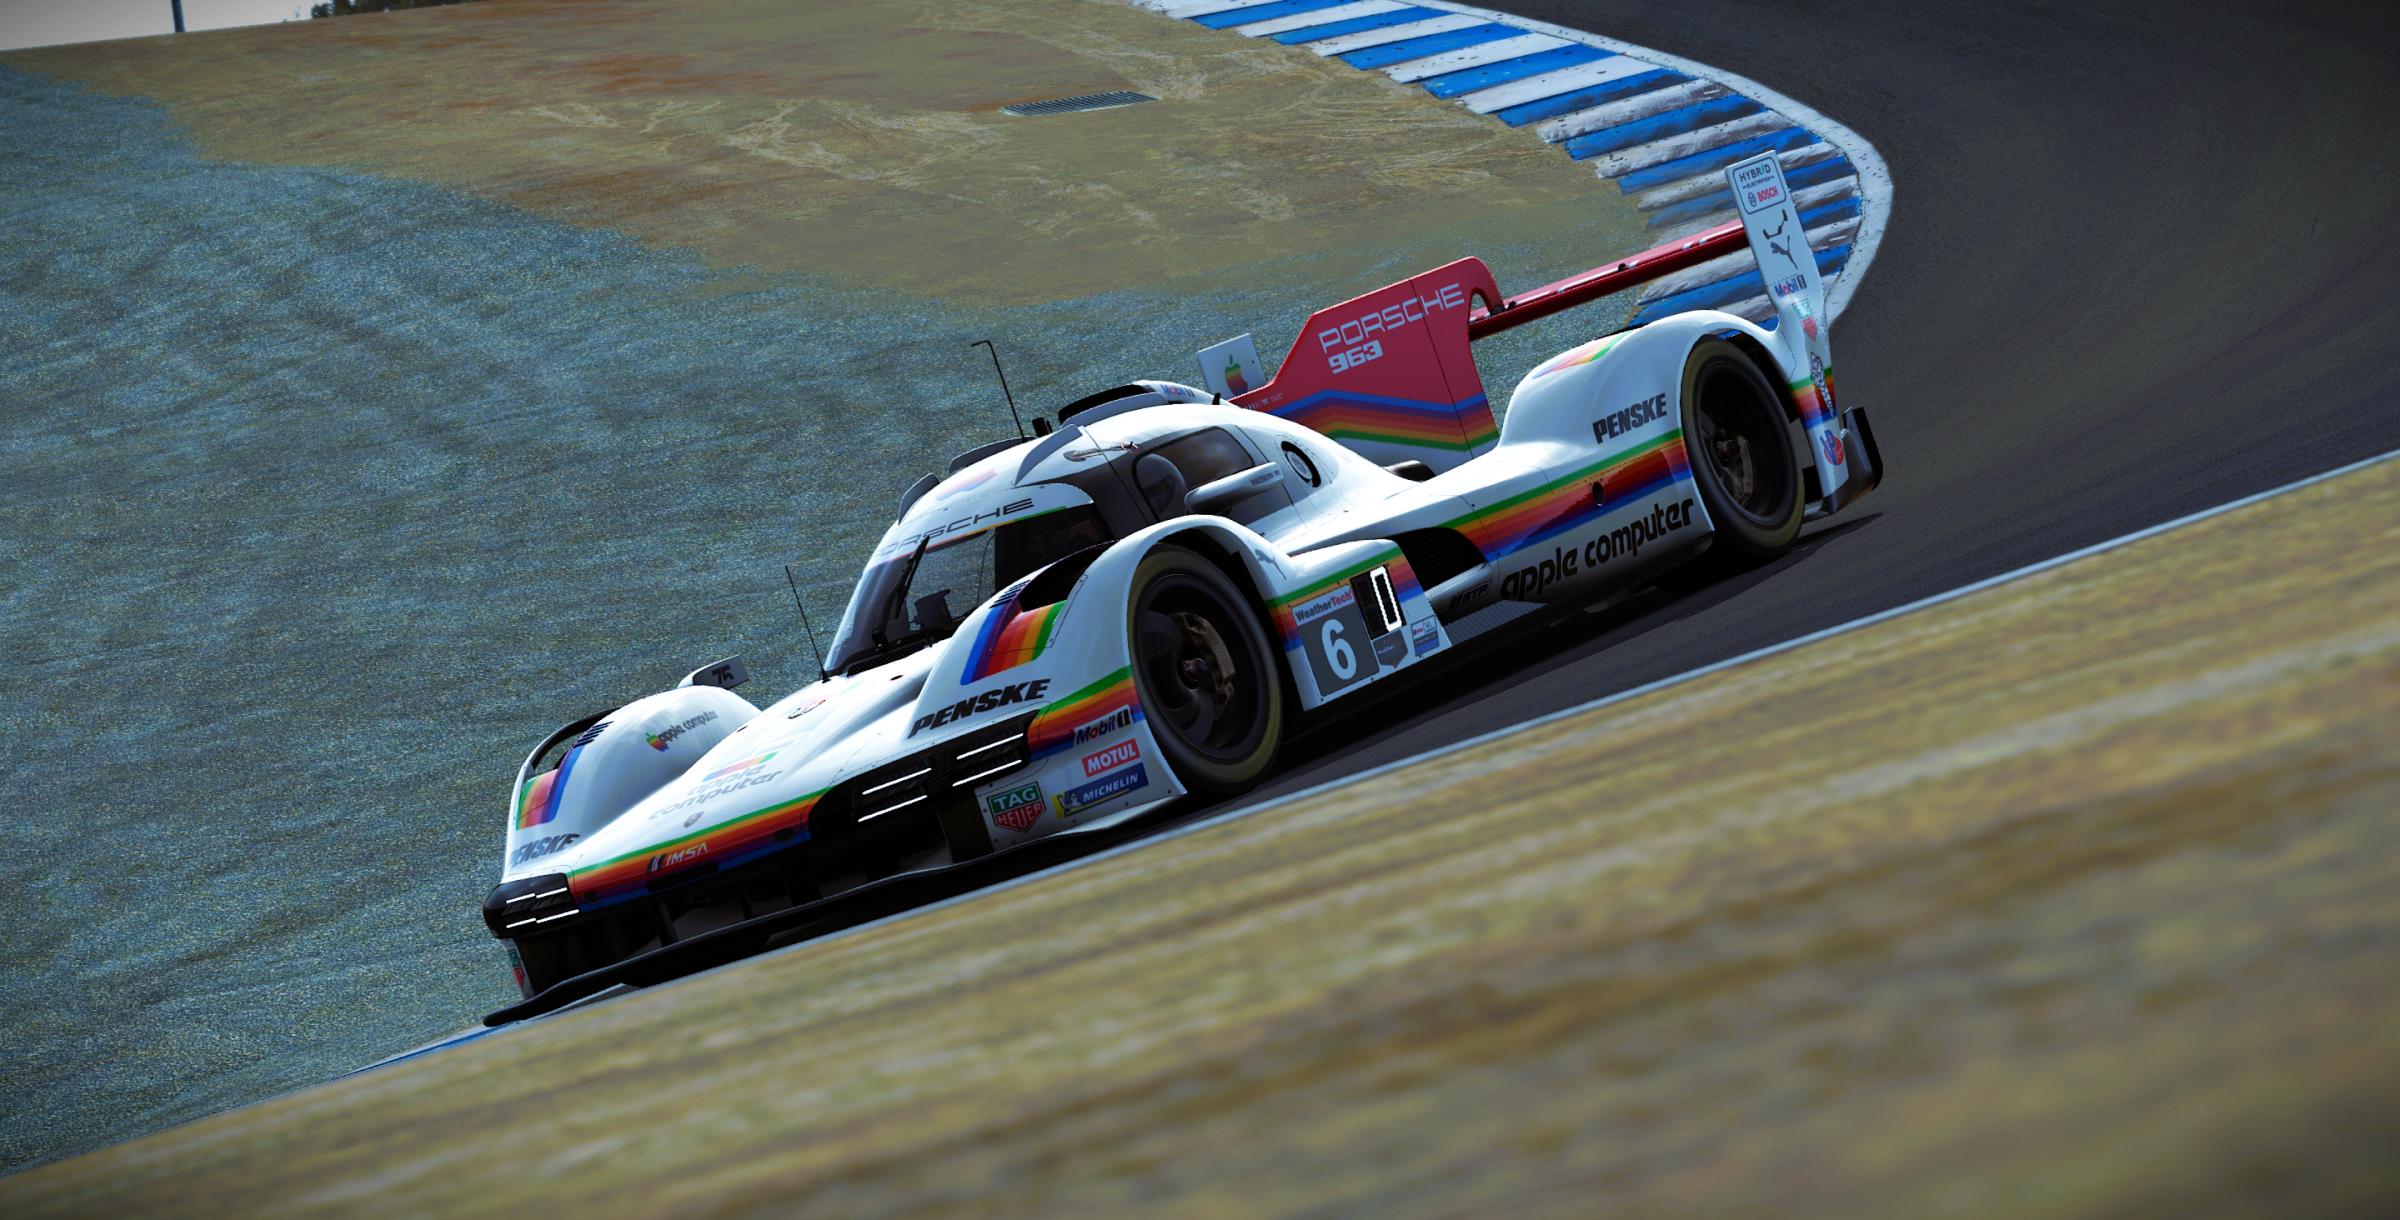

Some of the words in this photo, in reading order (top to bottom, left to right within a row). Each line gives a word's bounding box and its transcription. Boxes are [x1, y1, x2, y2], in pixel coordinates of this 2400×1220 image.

[1739, 163, 1771, 182] HYBRID
[1757, 185, 1779, 202] BOSCH
[1774, 278, 1799, 298] Mobil
[1318, 283, 1465, 353] PORSCHE
[1328, 340, 1383, 374] 963
[1592, 392, 1667, 444] PENSKE
[876, 498, 1034, 556] ORSCHE
[1501, 547, 1578, 600] apple
[1585, 498, 1694, 569] computer
[1296, 588, 1354, 621] WeatherTech
[1322, 618, 1357, 680] 6
[907, 678, 1051, 739] PENSKE
[1075, 717, 1116, 746] Mobil
[1116, 711, 1131, 729] 1
[1087, 743, 1137, 774] MOTUL
[649, 770, 783, 820] computer
[994, 787, 1037, 810] TAG
[1083, 773, 1138, 802] MICHELIN
[996, 804, 1042, 828] HEUER
[666, 843, 709, 866] IMSA
